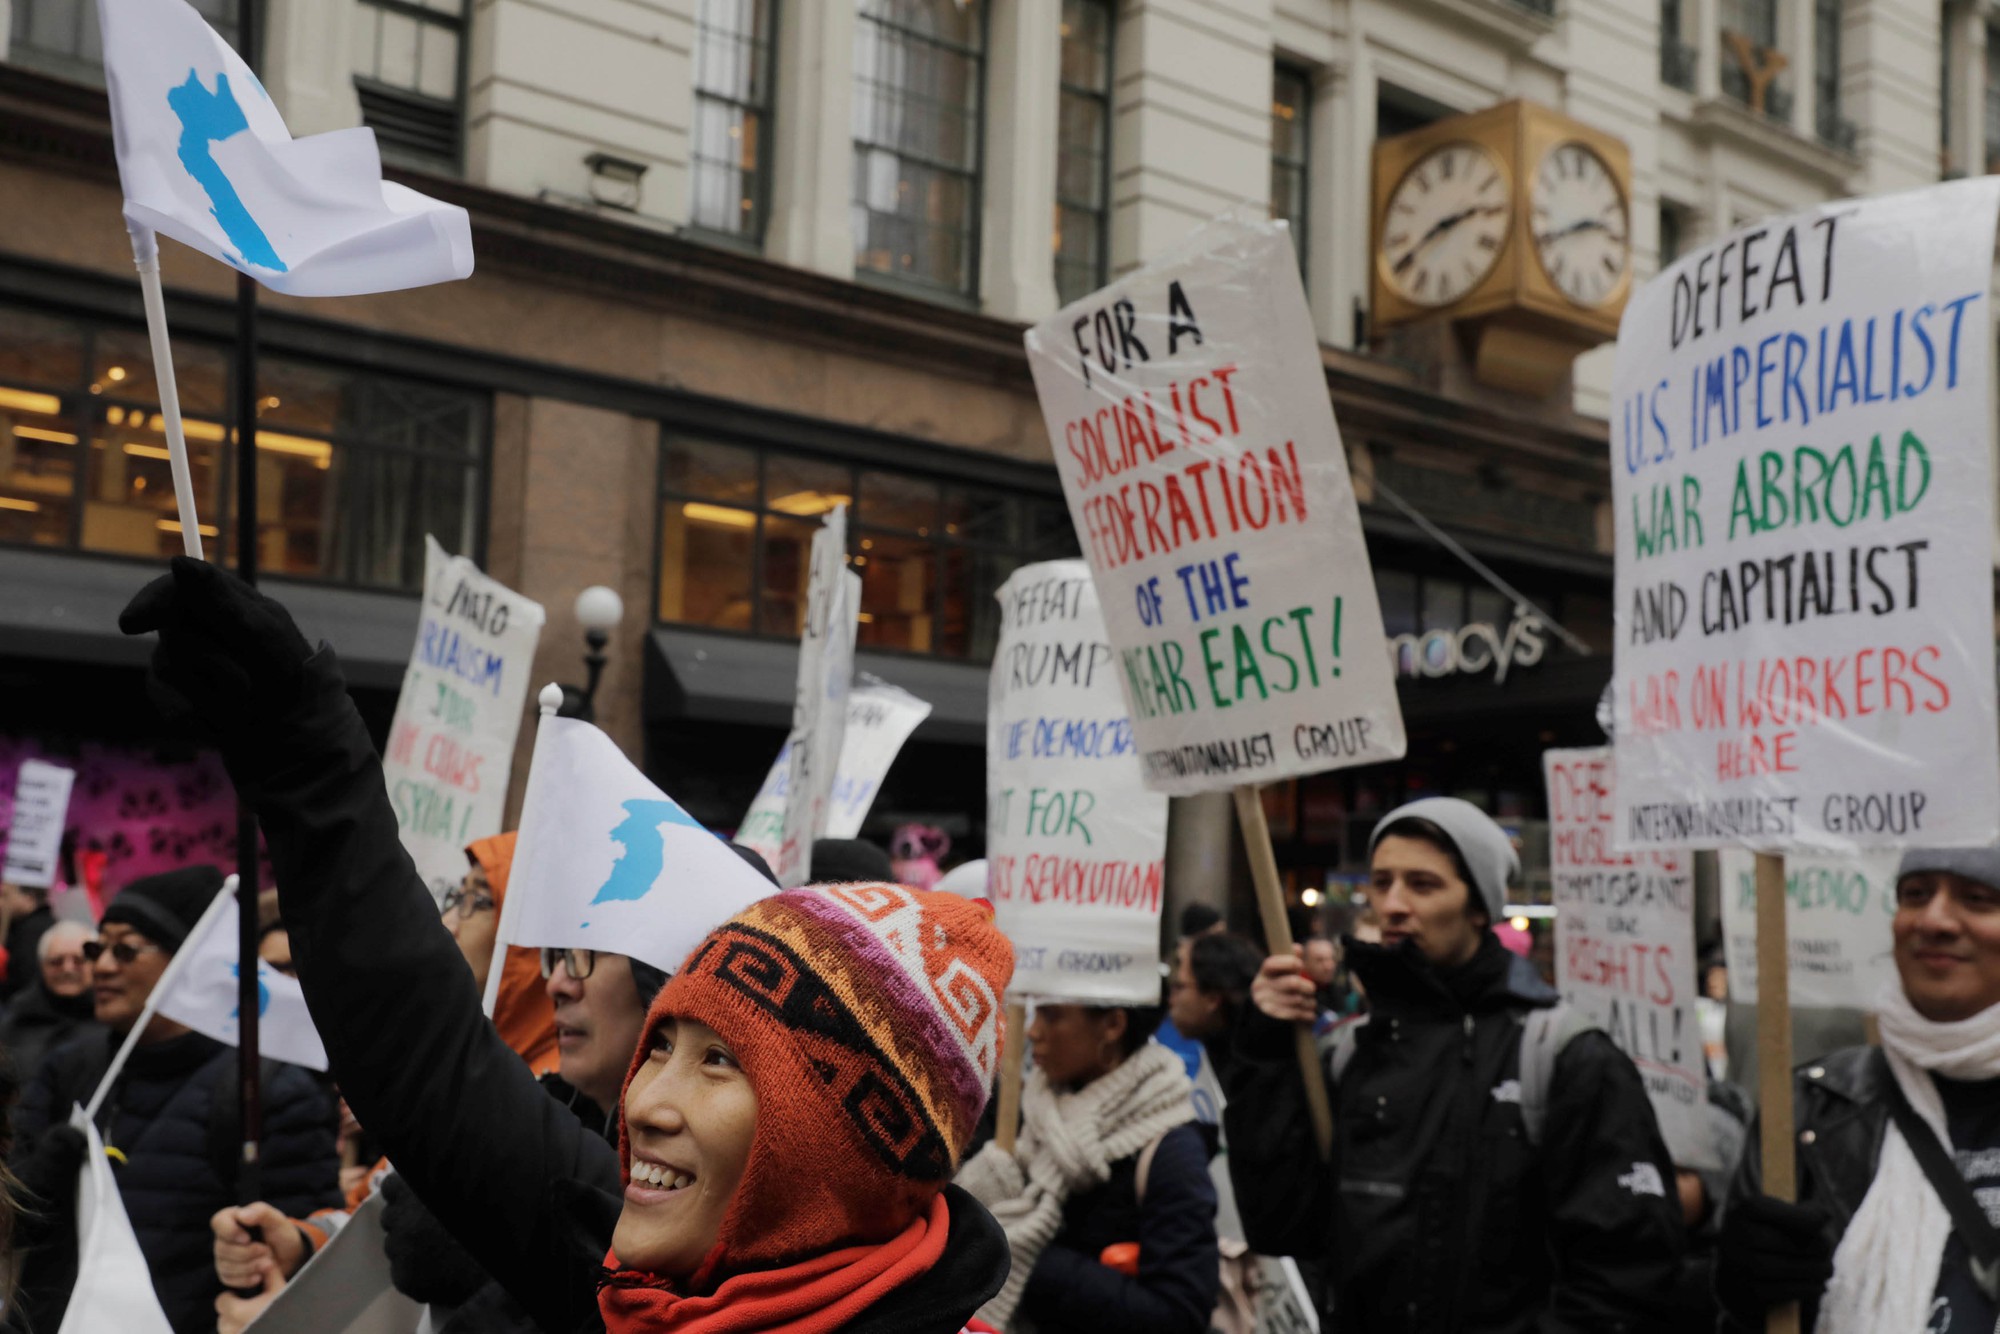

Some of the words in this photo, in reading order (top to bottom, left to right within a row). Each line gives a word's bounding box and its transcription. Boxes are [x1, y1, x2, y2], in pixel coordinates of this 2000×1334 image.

[1672, 209, 1859, 351] DEFEAT
[1072, 297, 1149, 389] FOR
[1167, 280, 1203, 355] A
[1065, 362, 1241, 490] SOCIALIST
[1624, 379, 1675, 475] U.S.
[1691, 291, 1982, 451] IMPERIALIST
[1083, 441, 1308, 569] FEDERATION
[1632, 474, 1704, 561] WAR
[1728, 429, 1932, 542] ABROAD
[1134, 577, 1163, 628] OF
[1176, 552, 1251, 622] THE
[1630, 582, 1687, 646] AND
[1702, 539, 1931, 637] CAPITALIST
[1009, 641, 1113, 691] RUMP
[1122, 640, 1198, 720] NEAR
[1199, 595, 1343, 708] EAST!
[1629, 669, 1683, 736] WAR
[1690, 659, 1729, 731] ON
[1738, 645, 1951, 731] WORKERS
[1294, 716, 1373, 761] GROUP
[1716, 731, 1800, 784] HERE
[1026, 786, 1096, 847] FOR
[1823, 791, 1928, 835] GROUP
[1021, 852, 1165, 914] REVOLUTION
[1566, 936, 1676, 1006] RIGHTS
